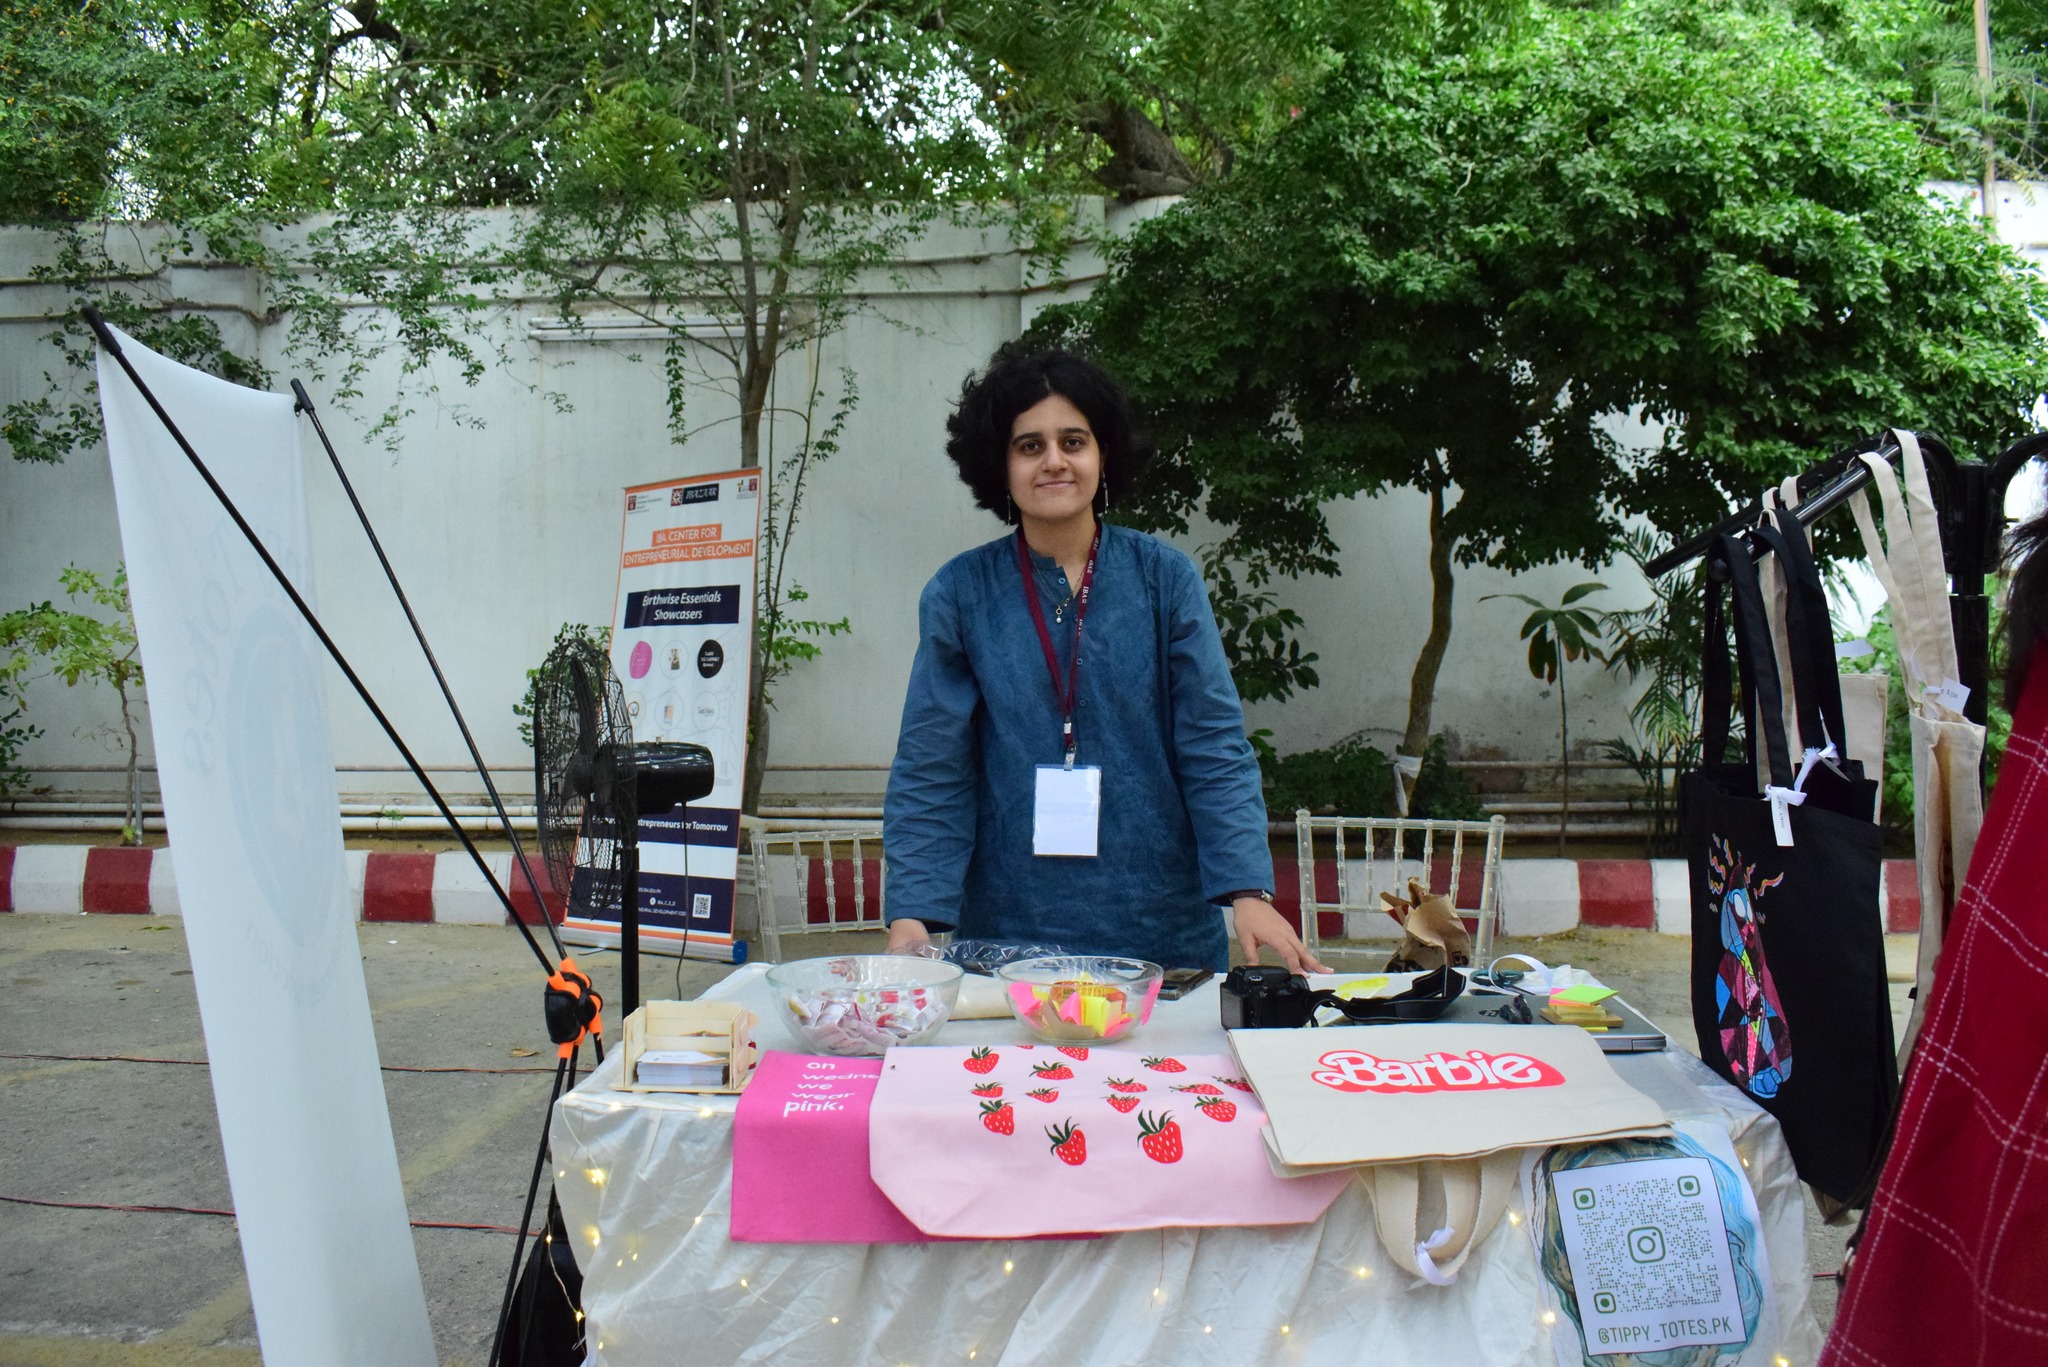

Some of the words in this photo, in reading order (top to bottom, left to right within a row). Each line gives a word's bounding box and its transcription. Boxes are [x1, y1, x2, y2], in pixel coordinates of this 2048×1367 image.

[668, 528, 700, 542] CENTER
[701, 527, 718, 539] FOR
[625, 550, 689, 565] ENTREPRENEURIAL
[691, 542, 751, 558] DEVELOPMENT
[680, 591, 722, 604] Essentials
[653, 609, 703, 621] Showcasers
[692, 821, 728, 831] Tomorrow
[806, 1062, 836, 1070] on
[1314, 1051, 1542, 1087] Barbie
[802, 1073, 879, 1081] wedne
[791, 1092, 855, 1100] wear
[783, 1100, 844, 1117] pink.
